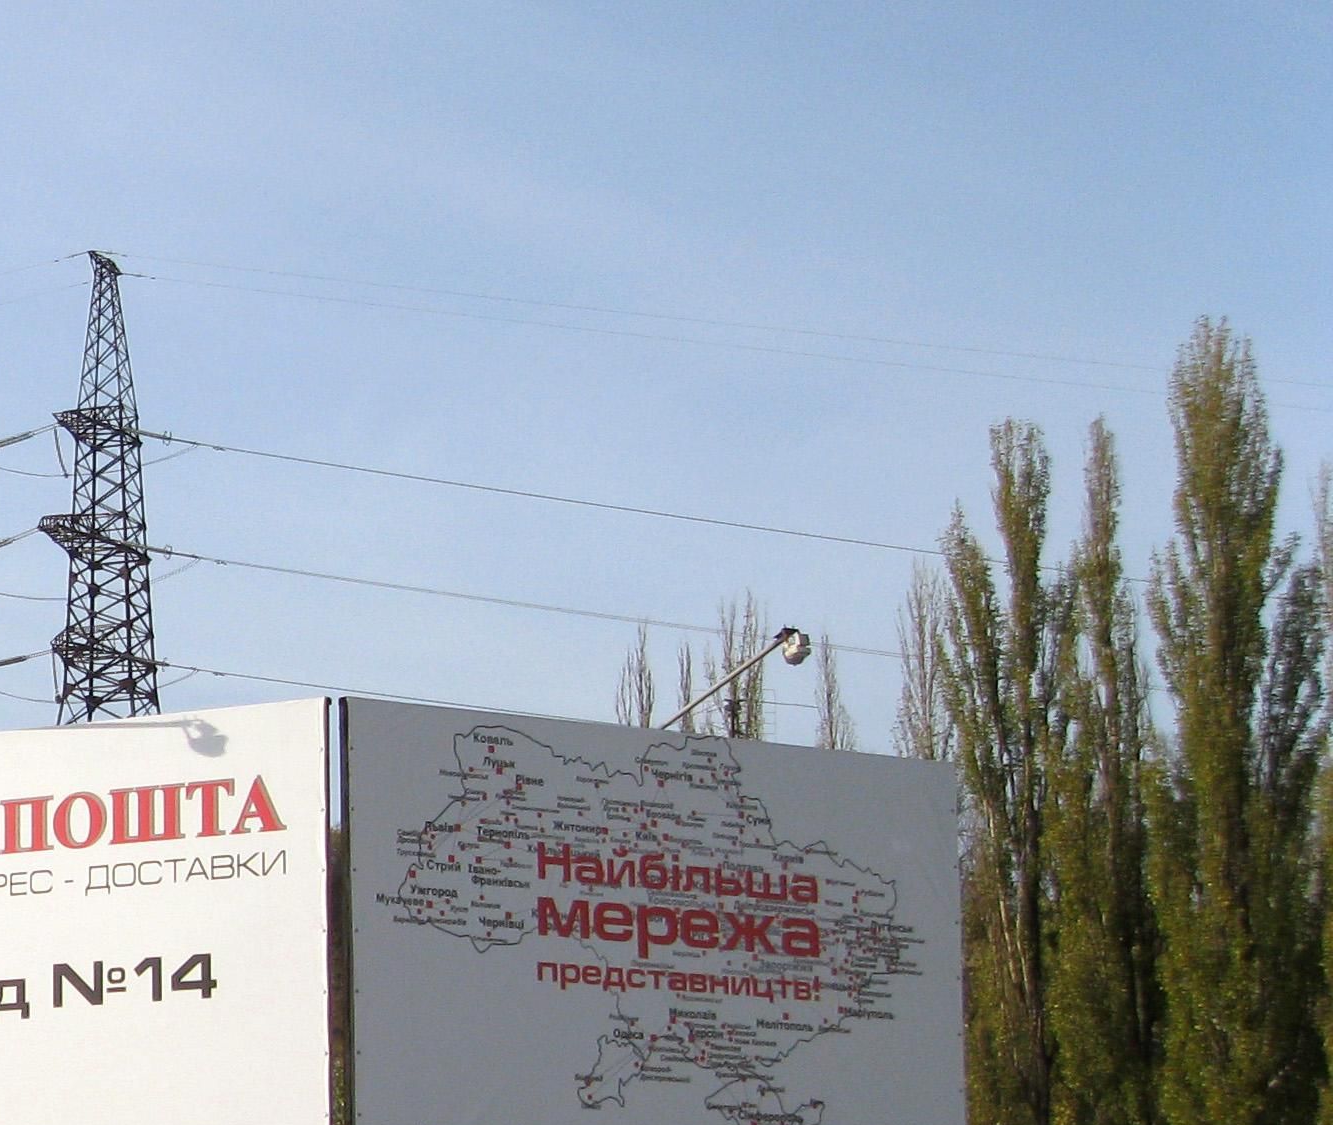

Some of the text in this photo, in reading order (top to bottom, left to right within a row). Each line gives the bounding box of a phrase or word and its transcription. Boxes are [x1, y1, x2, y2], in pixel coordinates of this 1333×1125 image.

[515, 774, 545, 787] Рівне
[0, 774, 287, 855] ПОШТА
[635, 830, 658, 842] Київ
[85, 850, 287, 896] ДОСТАВКИ
[426, 860, 462, 873] Стрий
[537, 841, 819, 904] Найбільша
[410, 884, 459, 899] Ужгород
[536, 896, 820, 959] мережа
[53, 953, 217, 1008] №14
[537, 961, 821, 1003] представництв!
